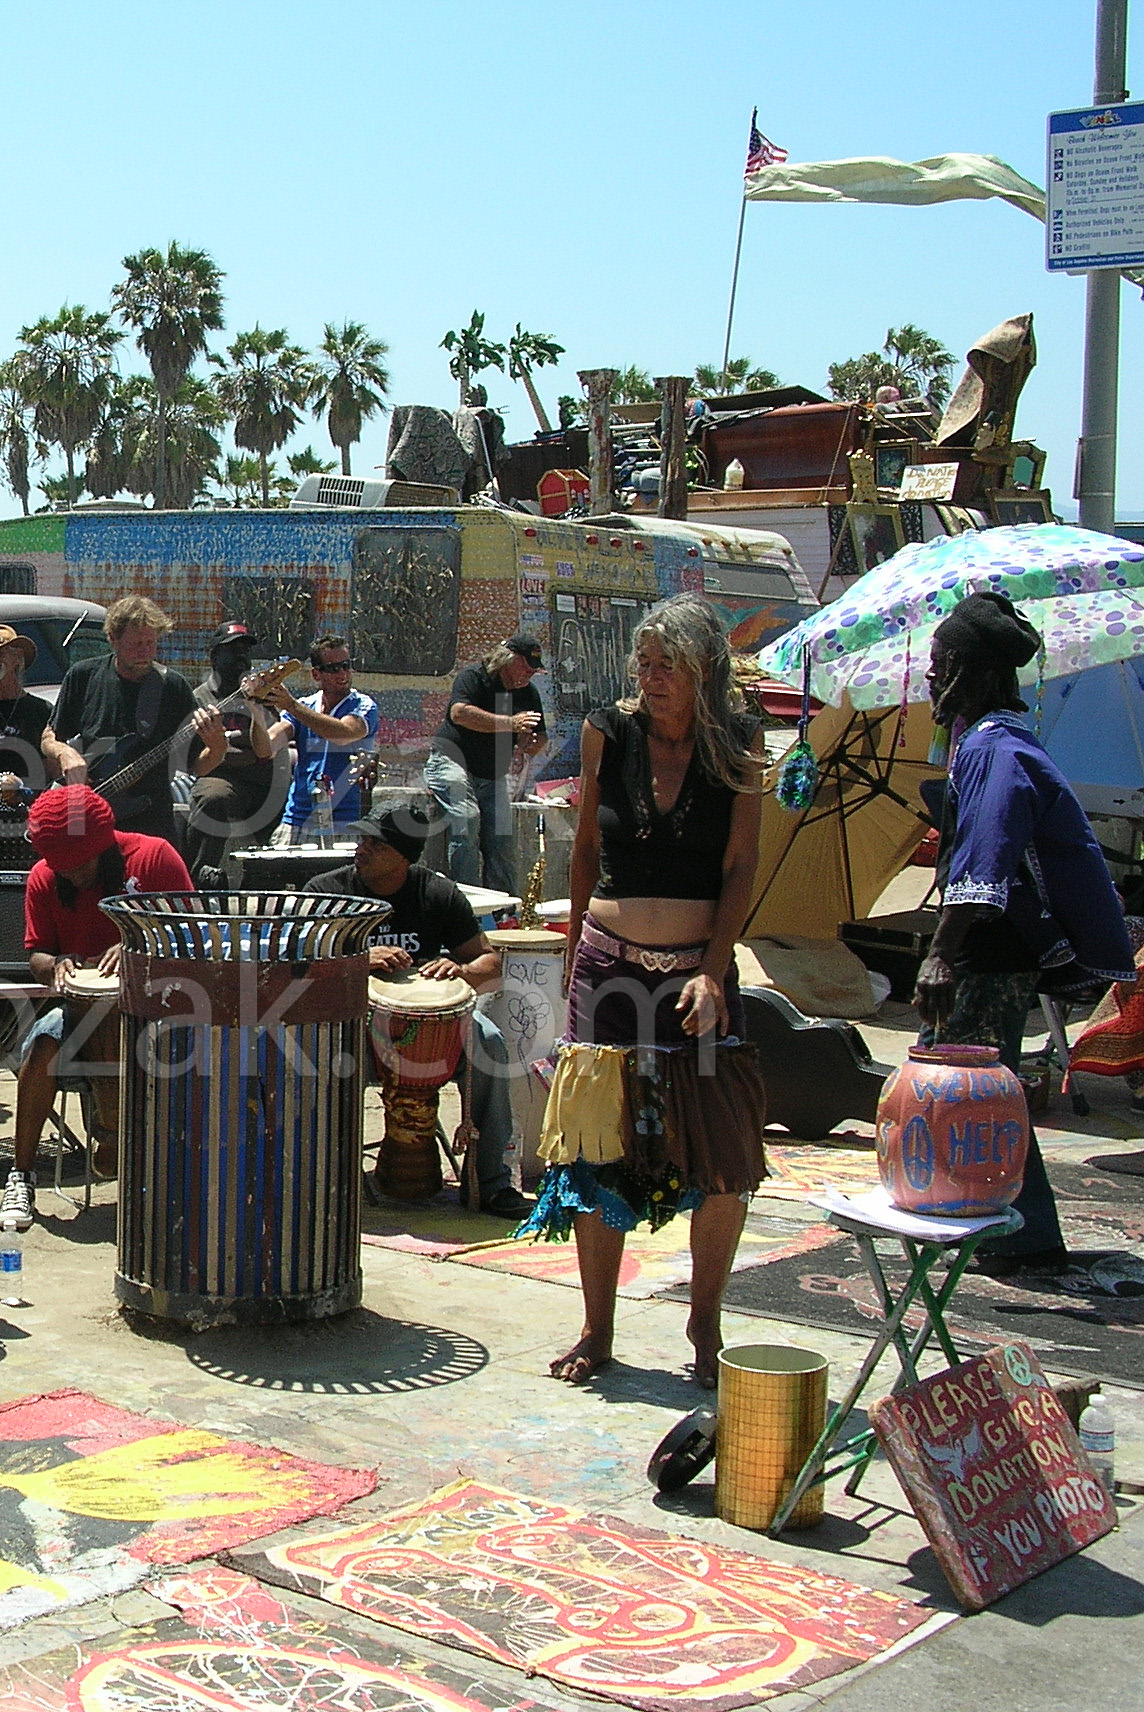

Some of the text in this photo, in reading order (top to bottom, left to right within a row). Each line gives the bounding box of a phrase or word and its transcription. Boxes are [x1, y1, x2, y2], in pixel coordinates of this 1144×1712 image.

[367, 932, 421, 953] EATLES
[948, 1115, 1024, 1167] HELP
[899, 1363, 1002, 1446] PLEASE
[1040, 1390, 1063, 1421] A
[947, 1430, 1072, 1523] DONATION
[963, 1475, 1107, 1588] IF YOU PHOTO
